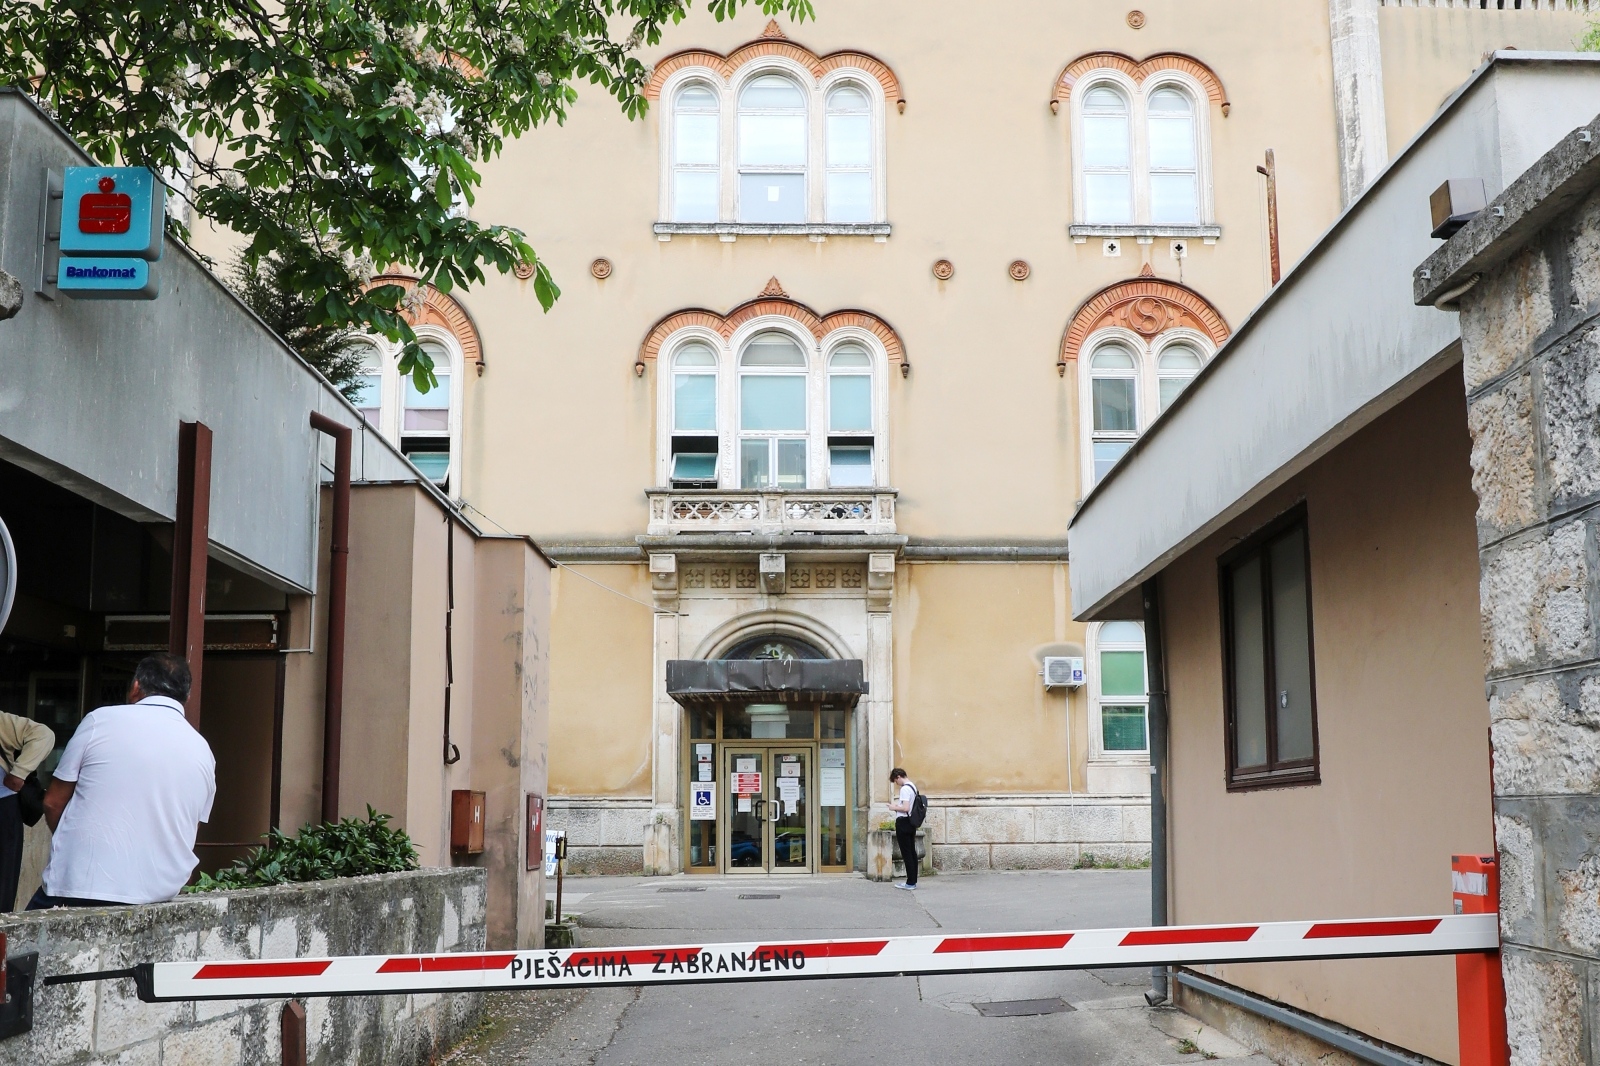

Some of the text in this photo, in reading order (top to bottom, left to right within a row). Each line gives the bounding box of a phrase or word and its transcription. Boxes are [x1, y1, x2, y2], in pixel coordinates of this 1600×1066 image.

[66, 266, 136, 278] Bankomat
[474, 805, 480, 823] H
[511, 949, 805, 979] PJEŠACIMA ZABRANJENO
